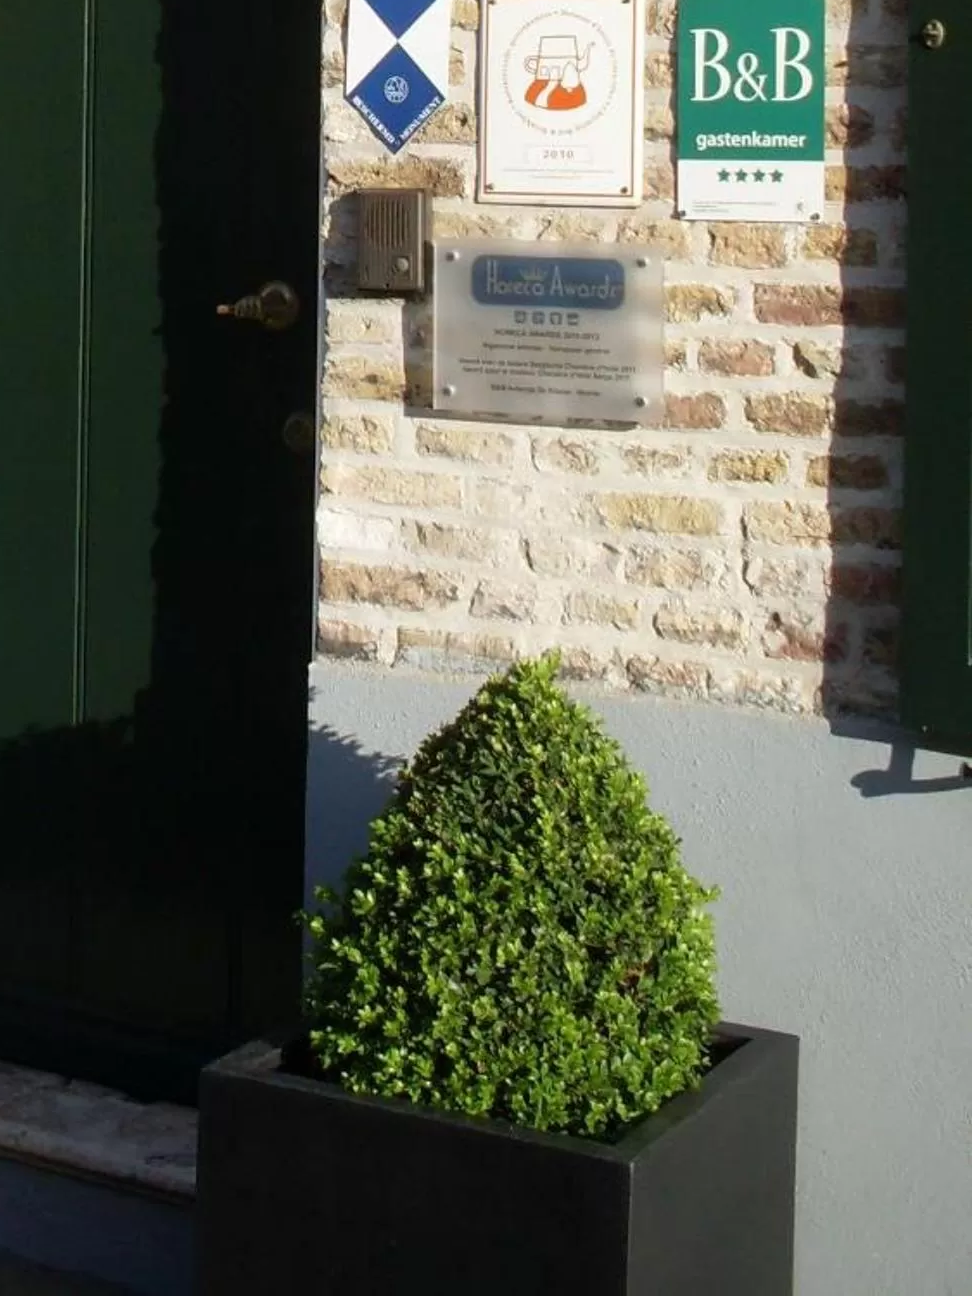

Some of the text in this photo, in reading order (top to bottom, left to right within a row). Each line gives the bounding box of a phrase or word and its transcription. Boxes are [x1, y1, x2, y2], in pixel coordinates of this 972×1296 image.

[689, 27, 813, 102] B&B
[696, 131, 807, 151] gastenkamer
[486, 259, 545, 297] Horeca
